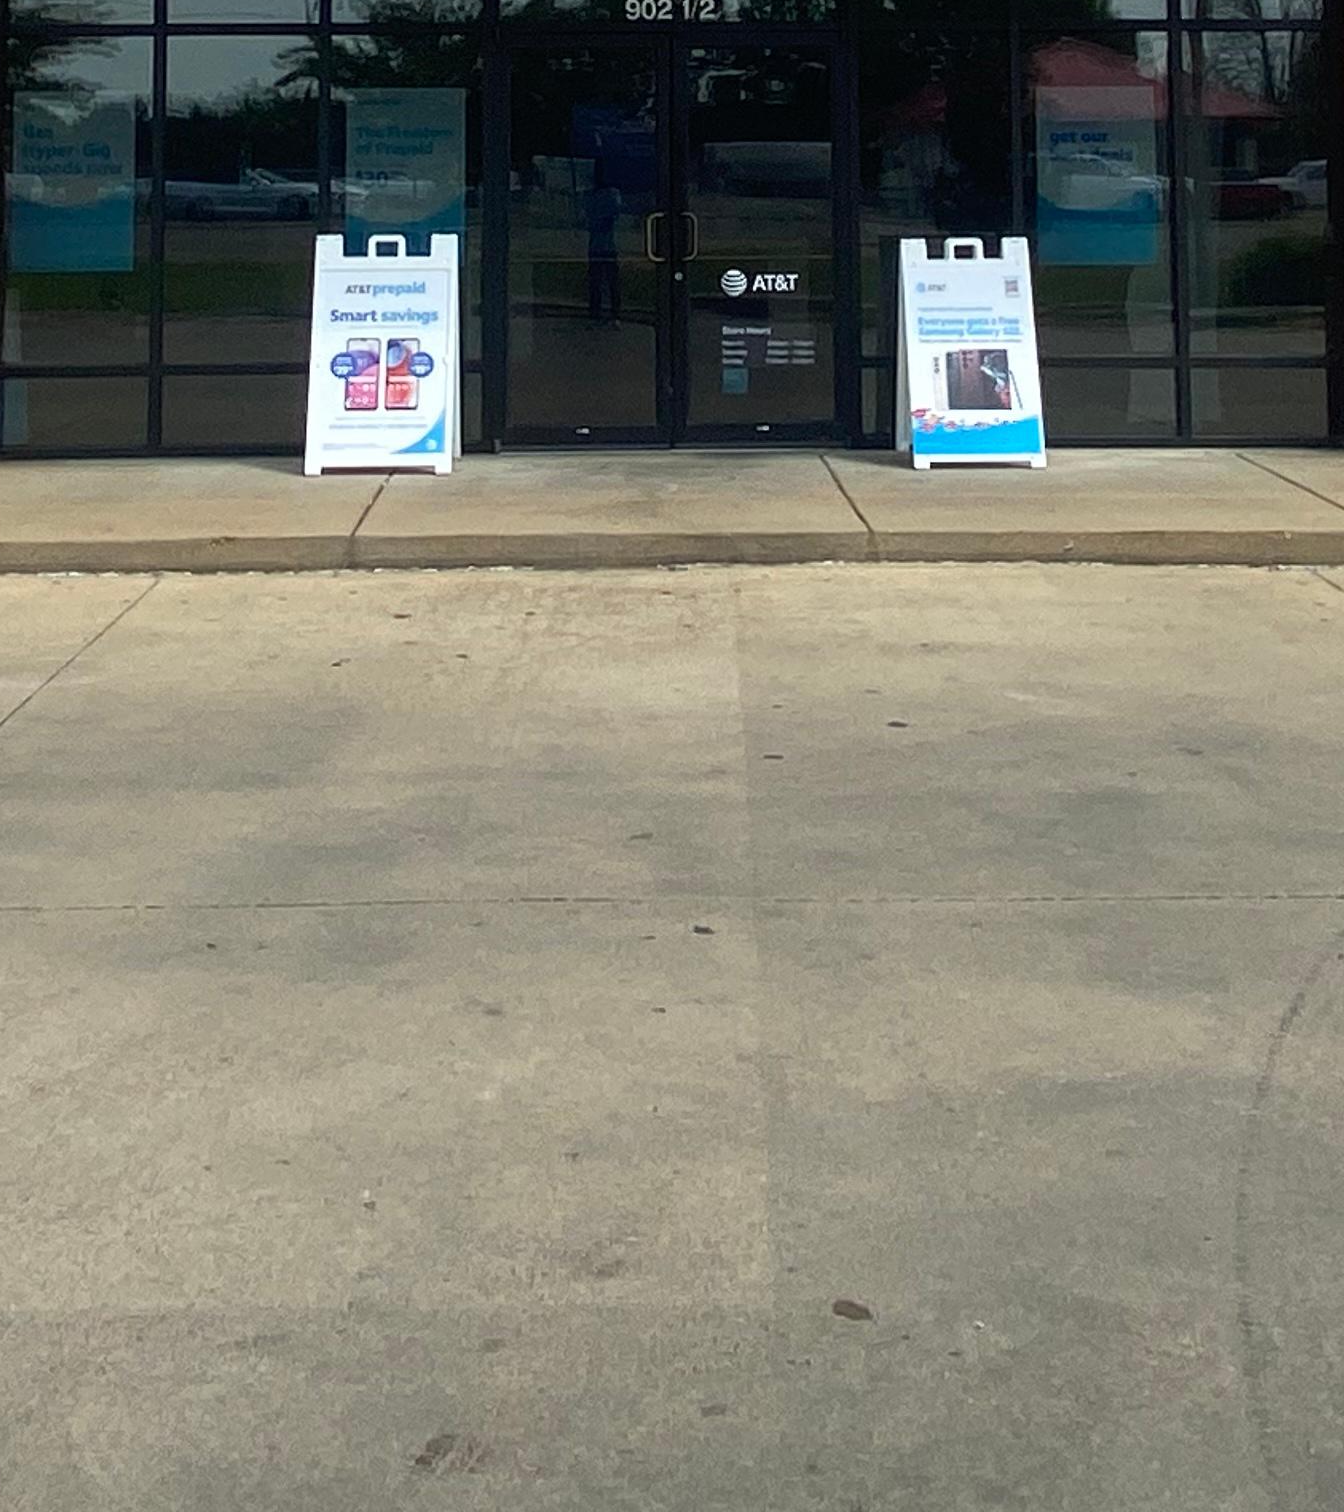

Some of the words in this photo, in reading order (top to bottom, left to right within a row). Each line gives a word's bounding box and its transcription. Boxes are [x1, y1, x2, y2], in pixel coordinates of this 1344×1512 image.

[372, 281, 426, 298] prepaid
[752, 273, 800, 293] AT&T
[329, 309, 378, 323] Smart
[381, 308, 439, 326] savings
